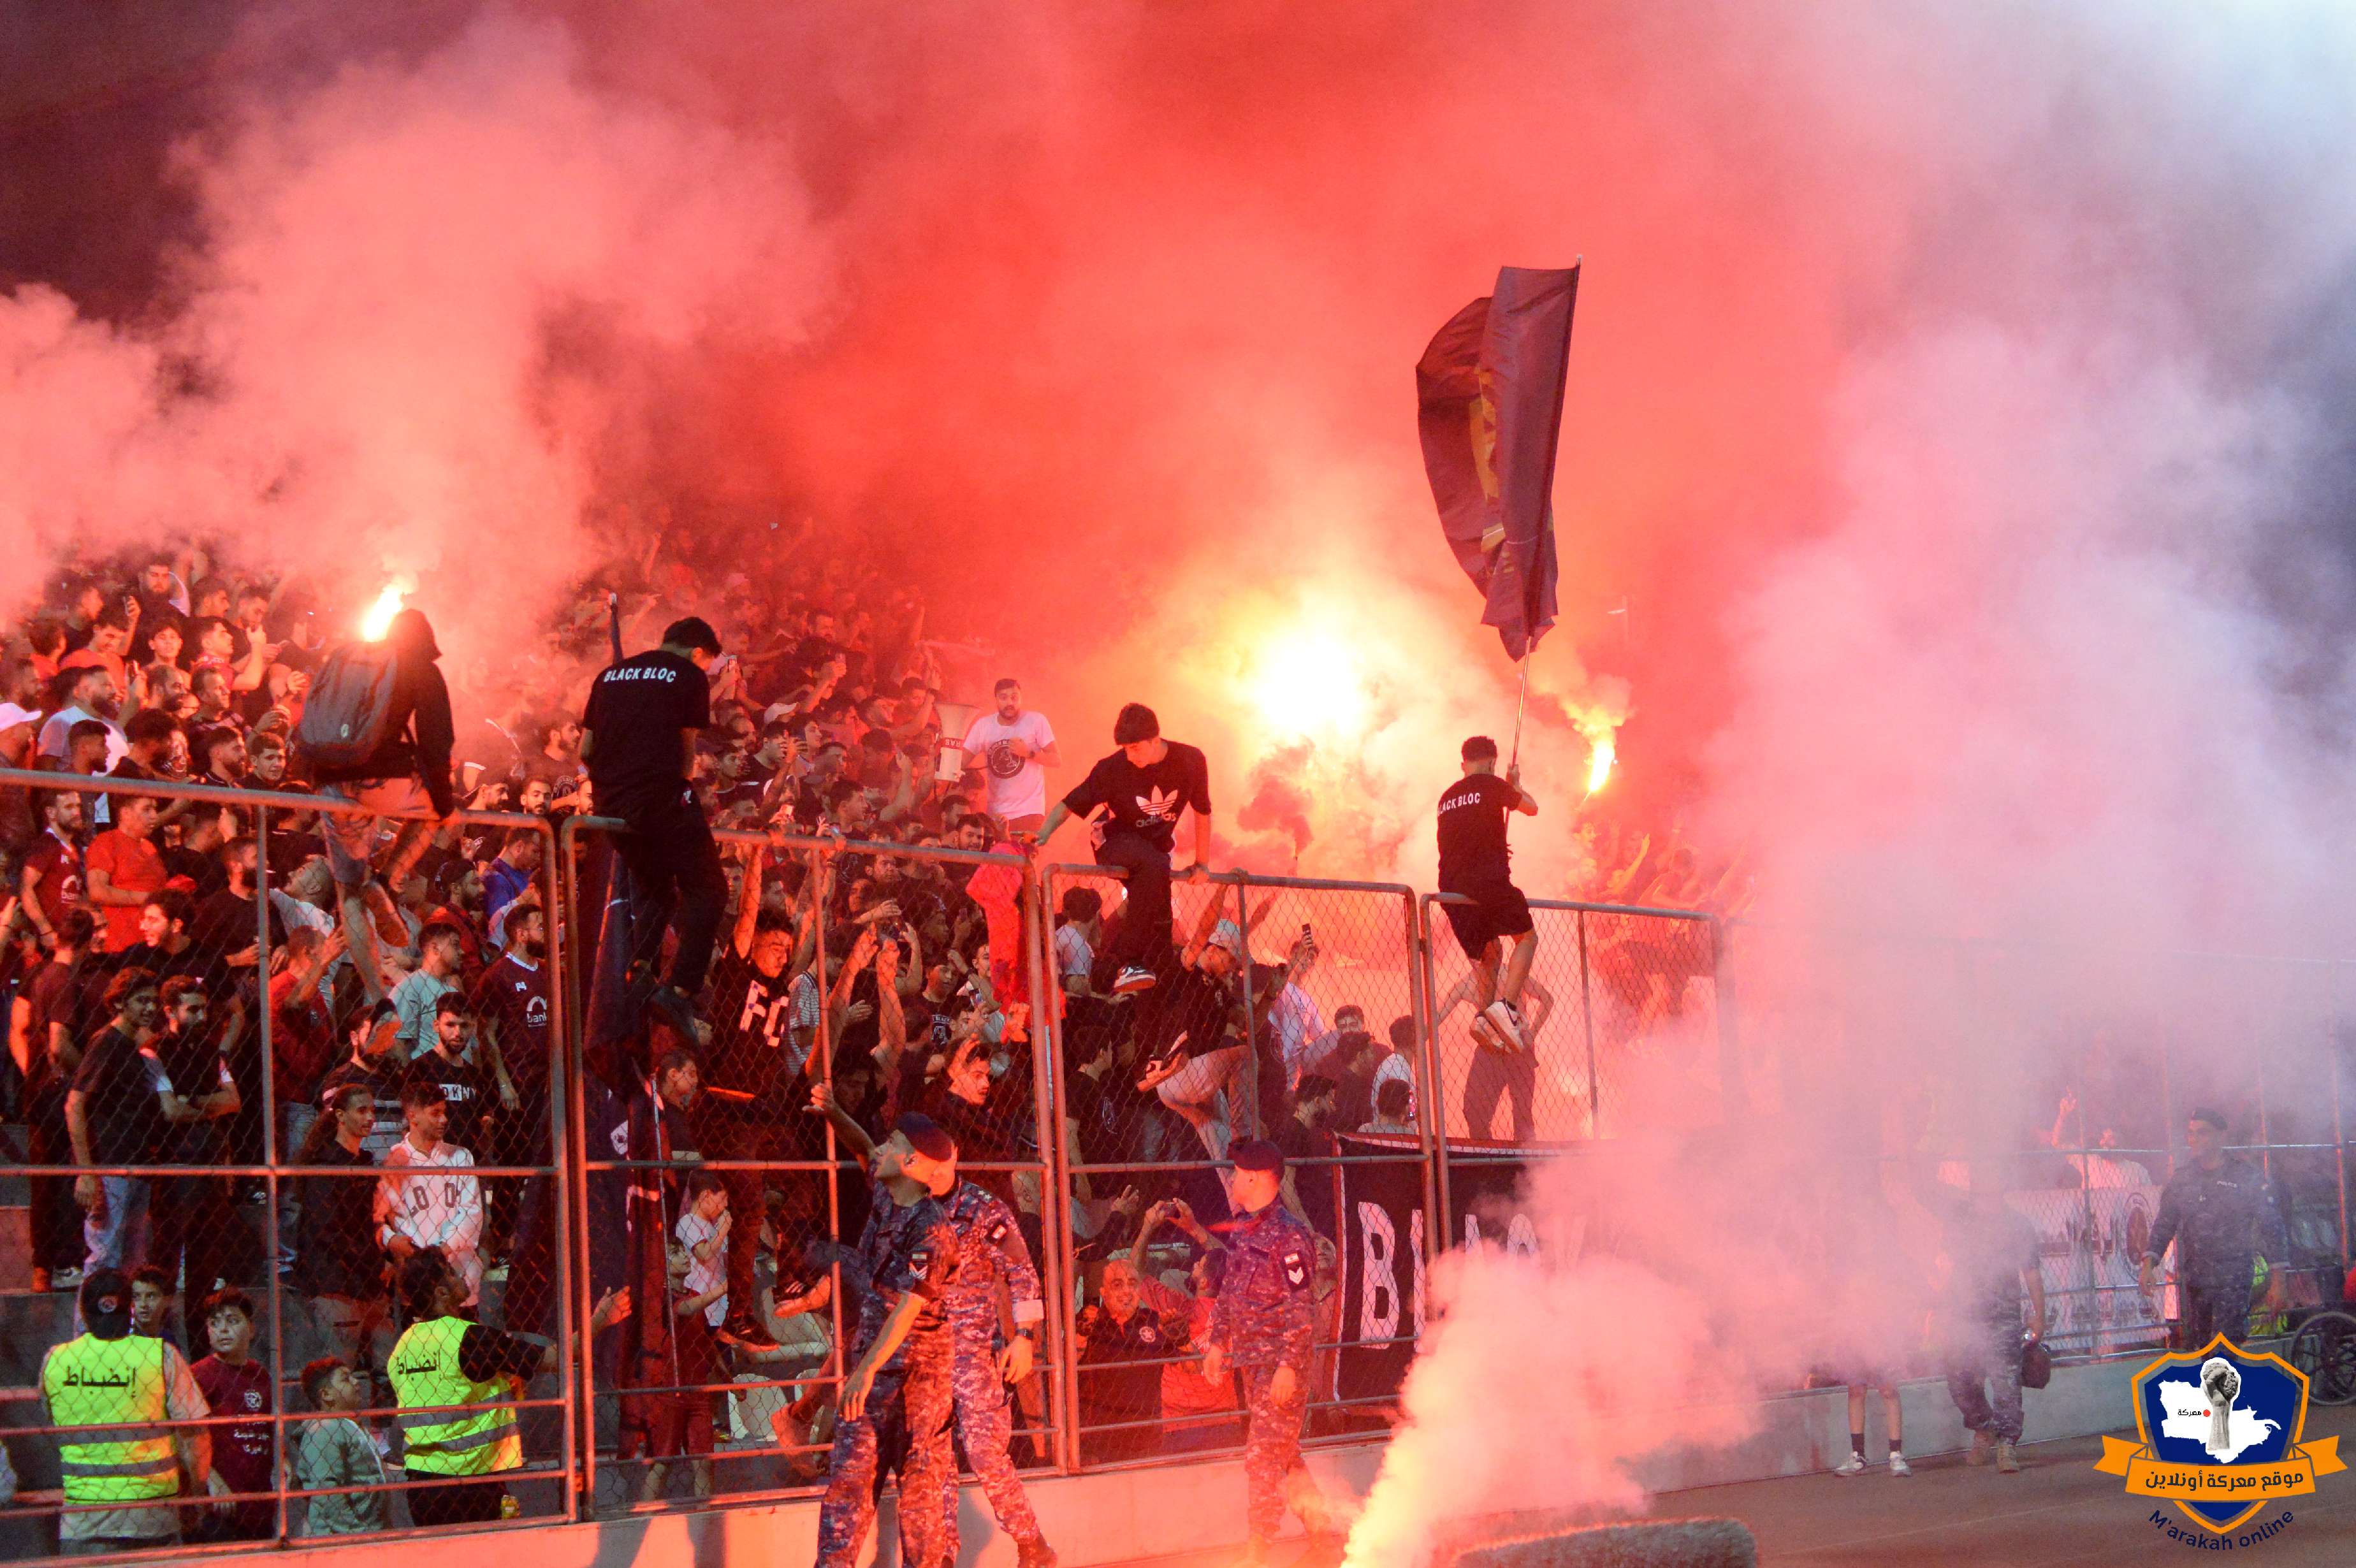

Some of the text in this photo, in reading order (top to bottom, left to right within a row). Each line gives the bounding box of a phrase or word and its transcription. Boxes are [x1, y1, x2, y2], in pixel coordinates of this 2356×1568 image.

[604, 667, 676, 683] BLACK BLOC
[1438, 792, 1480, 816] LACK BLOC
[1135, 812, 1177, 828] adias
[396, 1348, 442, 1381] إنضباط
[62, 1366, 136, 1399] إنضباط
